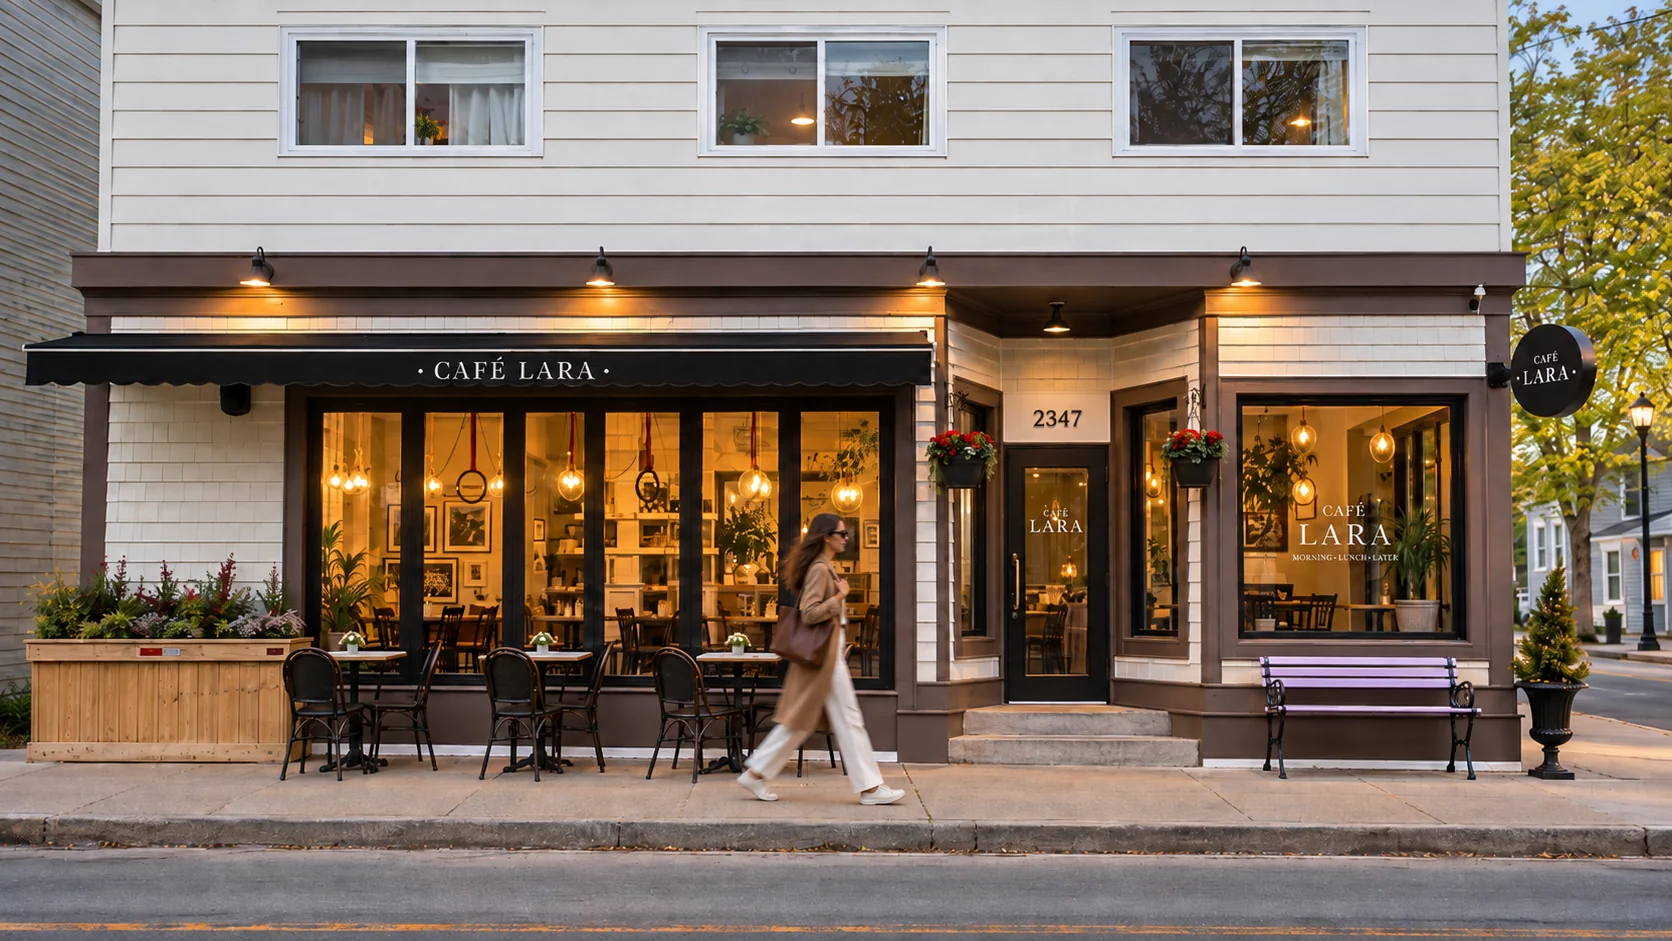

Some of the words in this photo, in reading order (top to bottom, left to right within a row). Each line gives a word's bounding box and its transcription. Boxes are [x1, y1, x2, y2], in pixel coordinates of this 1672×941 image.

[1533, 351, 1558, 364] CAFÉ
[434, 357, 506, 380] CAFÉ
[519, 361, 596, 380] LARA
[1523, 365, 1569, 386] LARA
[1033, 409, 1082, 428] 2347
[1043, 507, 1069, 517] CAFÉ
[1322, 501, 1366, 517] CAFÉ
[1030, 519, 1083, 533] LARA
[1299, 523, 1391, 546] LARA
